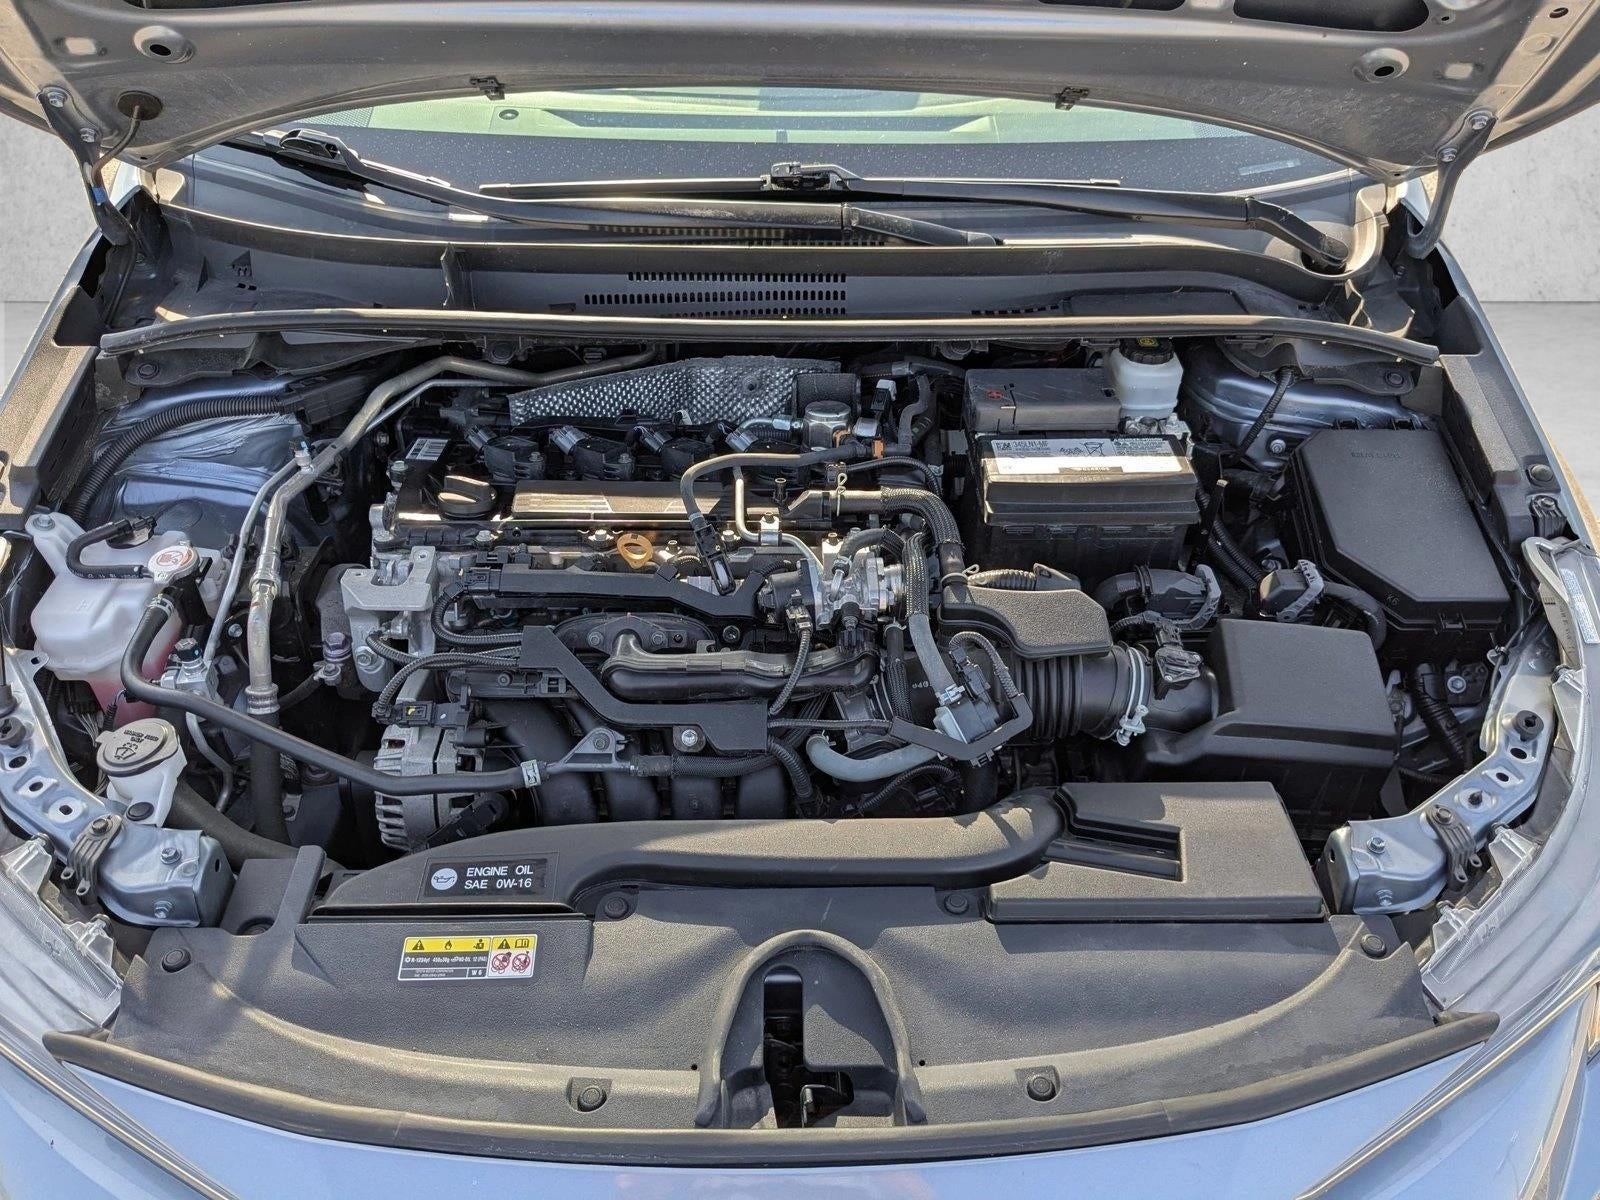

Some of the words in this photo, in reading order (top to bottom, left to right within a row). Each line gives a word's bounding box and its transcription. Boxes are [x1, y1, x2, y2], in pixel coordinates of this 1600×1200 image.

[466, 865, 508, 877] ENGINE
[515, 865, 534, 875] OIL
[464, 879, 488, 889] SAE
[496, 878, 532, 889] 0W-16
